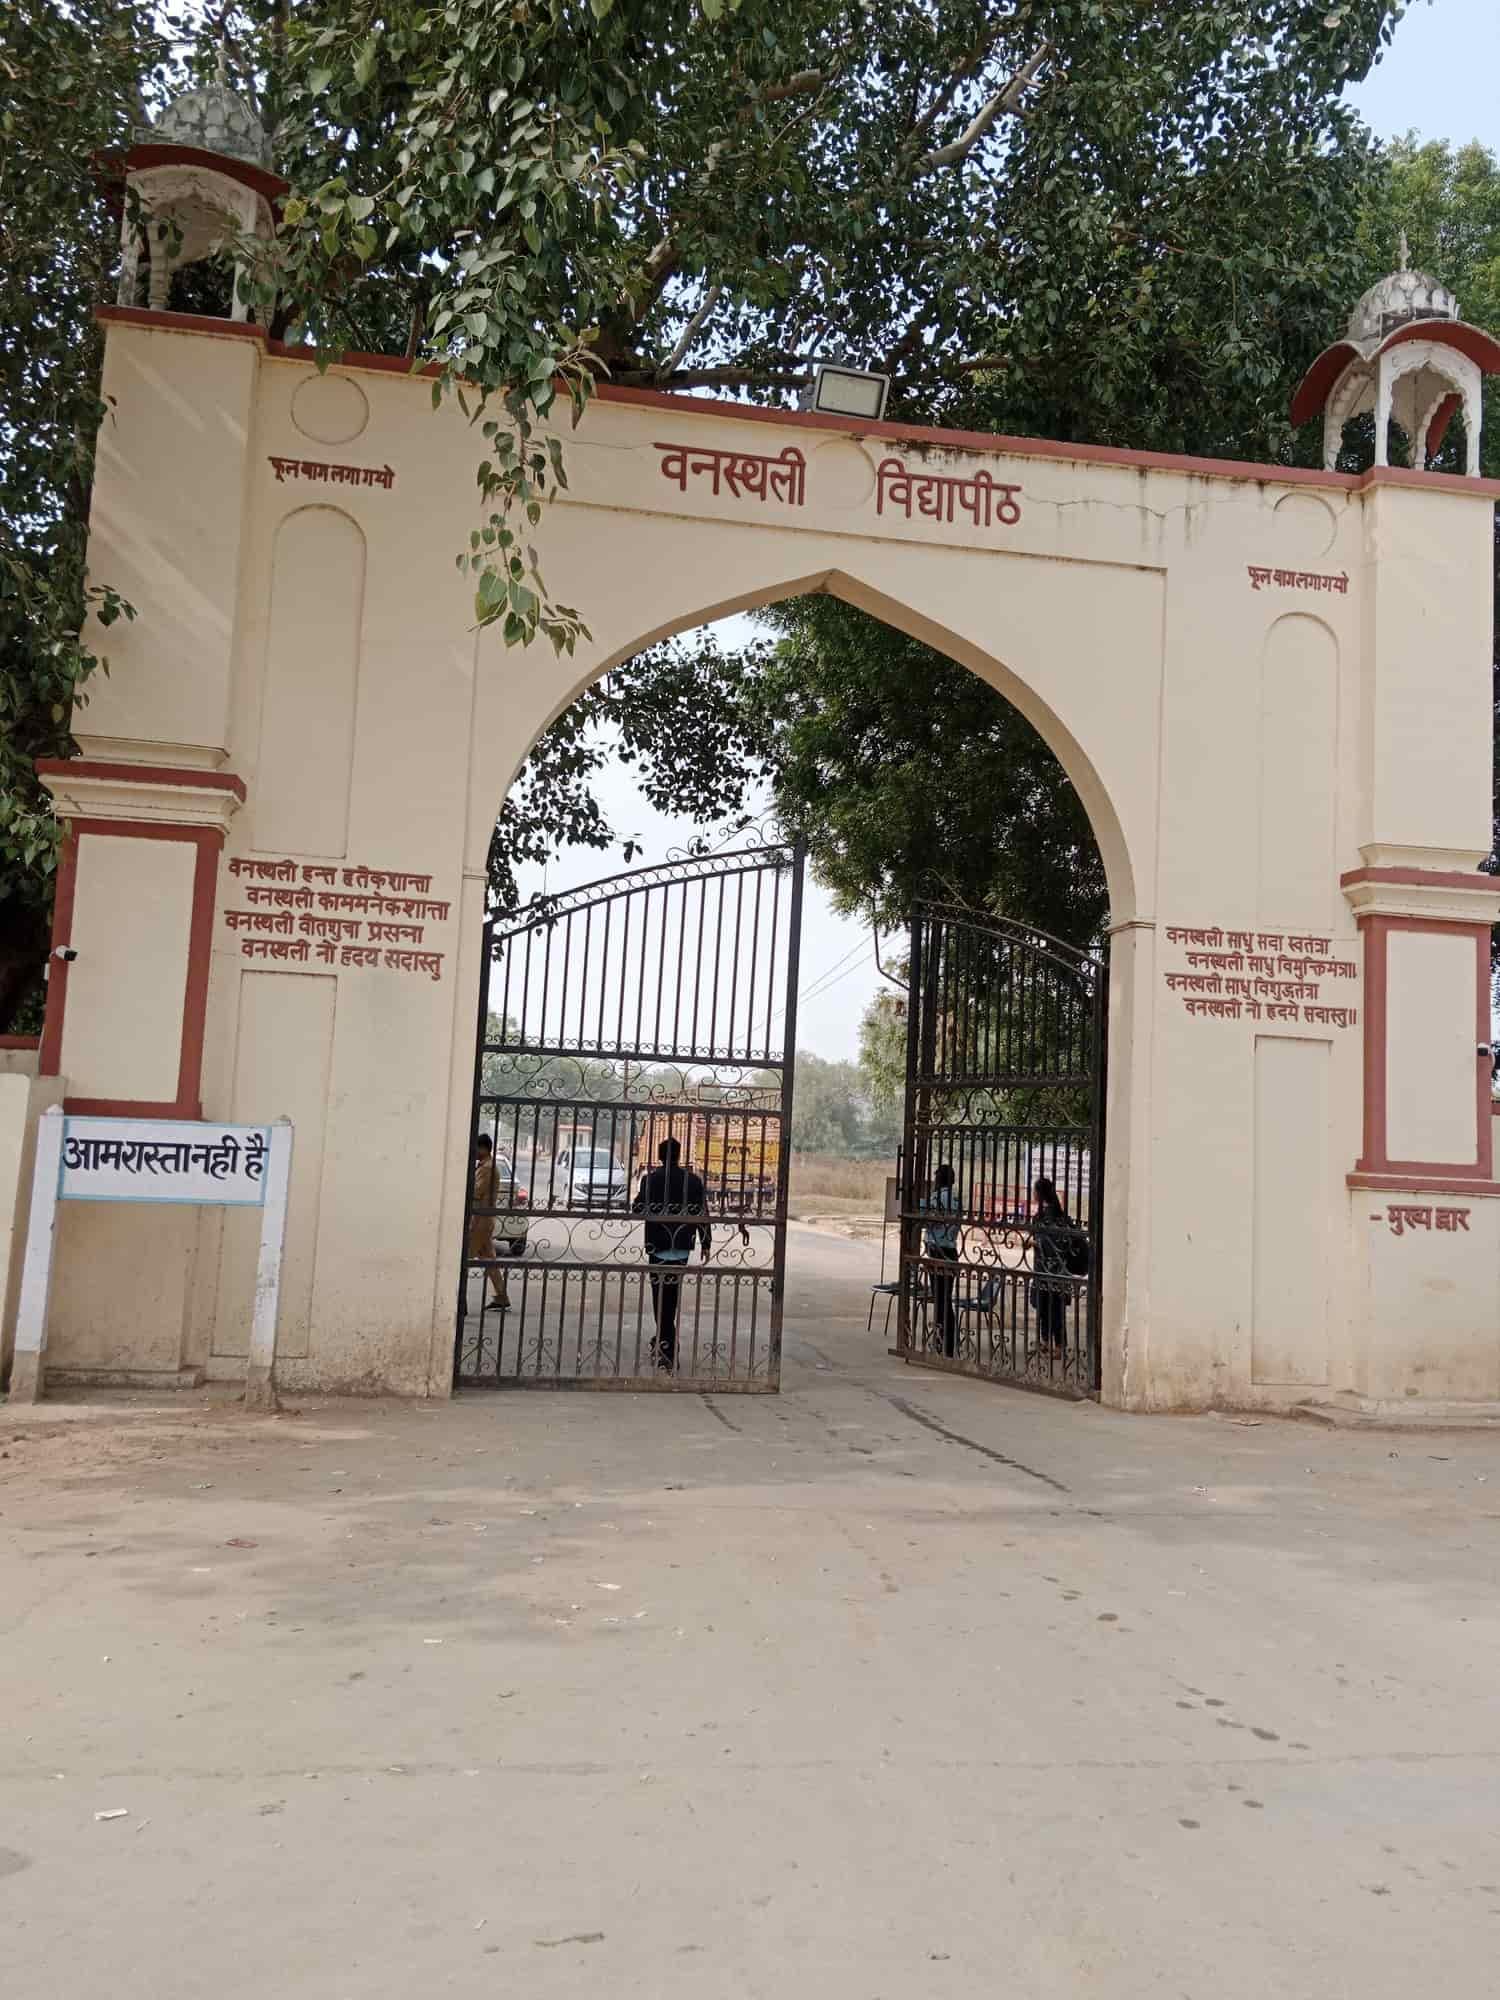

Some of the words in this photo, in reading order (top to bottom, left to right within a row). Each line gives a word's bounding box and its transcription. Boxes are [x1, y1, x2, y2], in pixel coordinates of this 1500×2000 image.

[652, 442, 806, 505] वनस्थली
[877, 457, 1022, 526] विद्यापीठ
[228, 858, 298, 883] वनस्थली
[245, 886, 314, 909] वनस्थली
[224, 910, 295, 934] वनस्थली
[1165, 926, 1224, 947] वनस्थली
[241, 938, 311, 961] वनस्थली
[1185, 951, 1244, 972] वनस्थली
[1164, 972, 1222, 993] वनस्थली
[1183, 997, 1242, 1019] वनस्थली
[62, 1137, 124, 1170] आम
[122, 1140, 192, 1175] रास्ता
[244, 1133, 270, 1181] है
